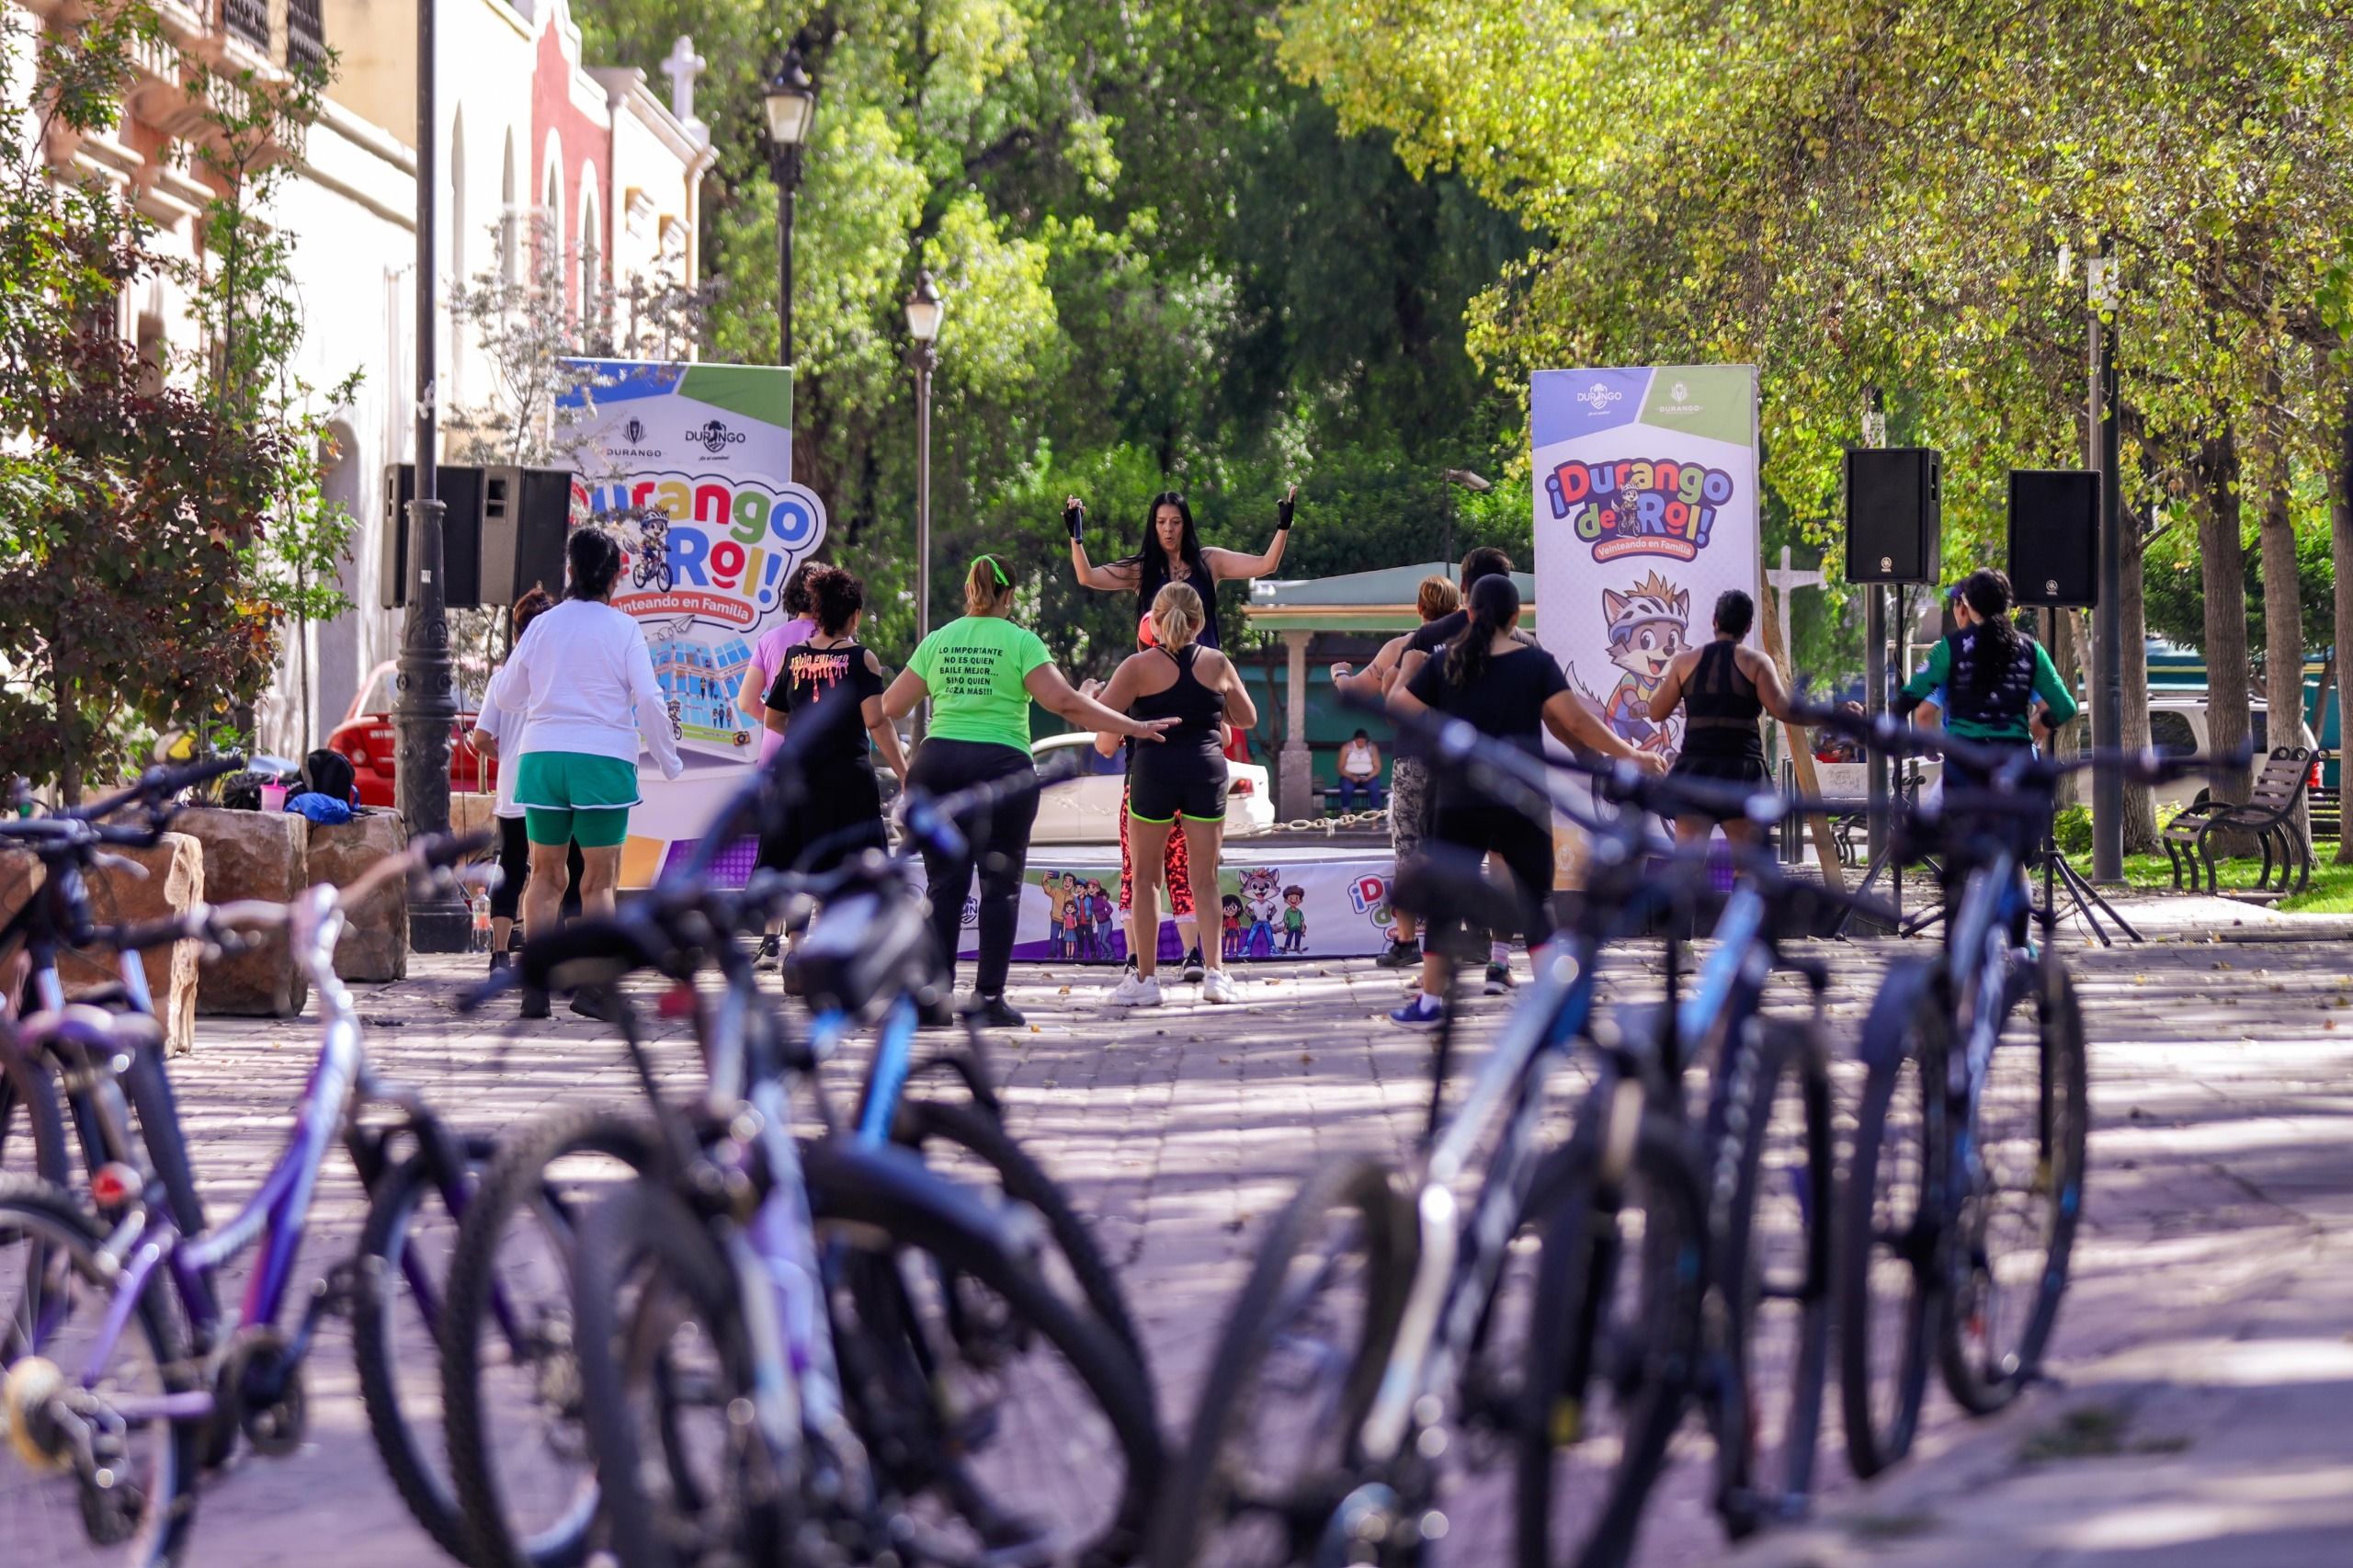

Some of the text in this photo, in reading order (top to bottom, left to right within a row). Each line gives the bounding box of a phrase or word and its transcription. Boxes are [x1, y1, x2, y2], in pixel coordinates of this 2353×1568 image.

[607, 448, 662, 458] DURANGO
[1549, 462, 1730, 519] ¡Durango
[1578, 493, 1711, 544] de Rol!
[1598, 540, 1646, 556] Veinteando
[1661, 540, 1691, 555] Familia
[665, 527, 782, 604] Rol!
[614, 596, 749, 620] inteando en Familia
[951, 647, 1003, 656] IMPORTANTE
[971, 657, 994, 665] QUIEN
[964, 667, 999, 676] MEJOR...
[945, 687, 964, 695] GOZA
